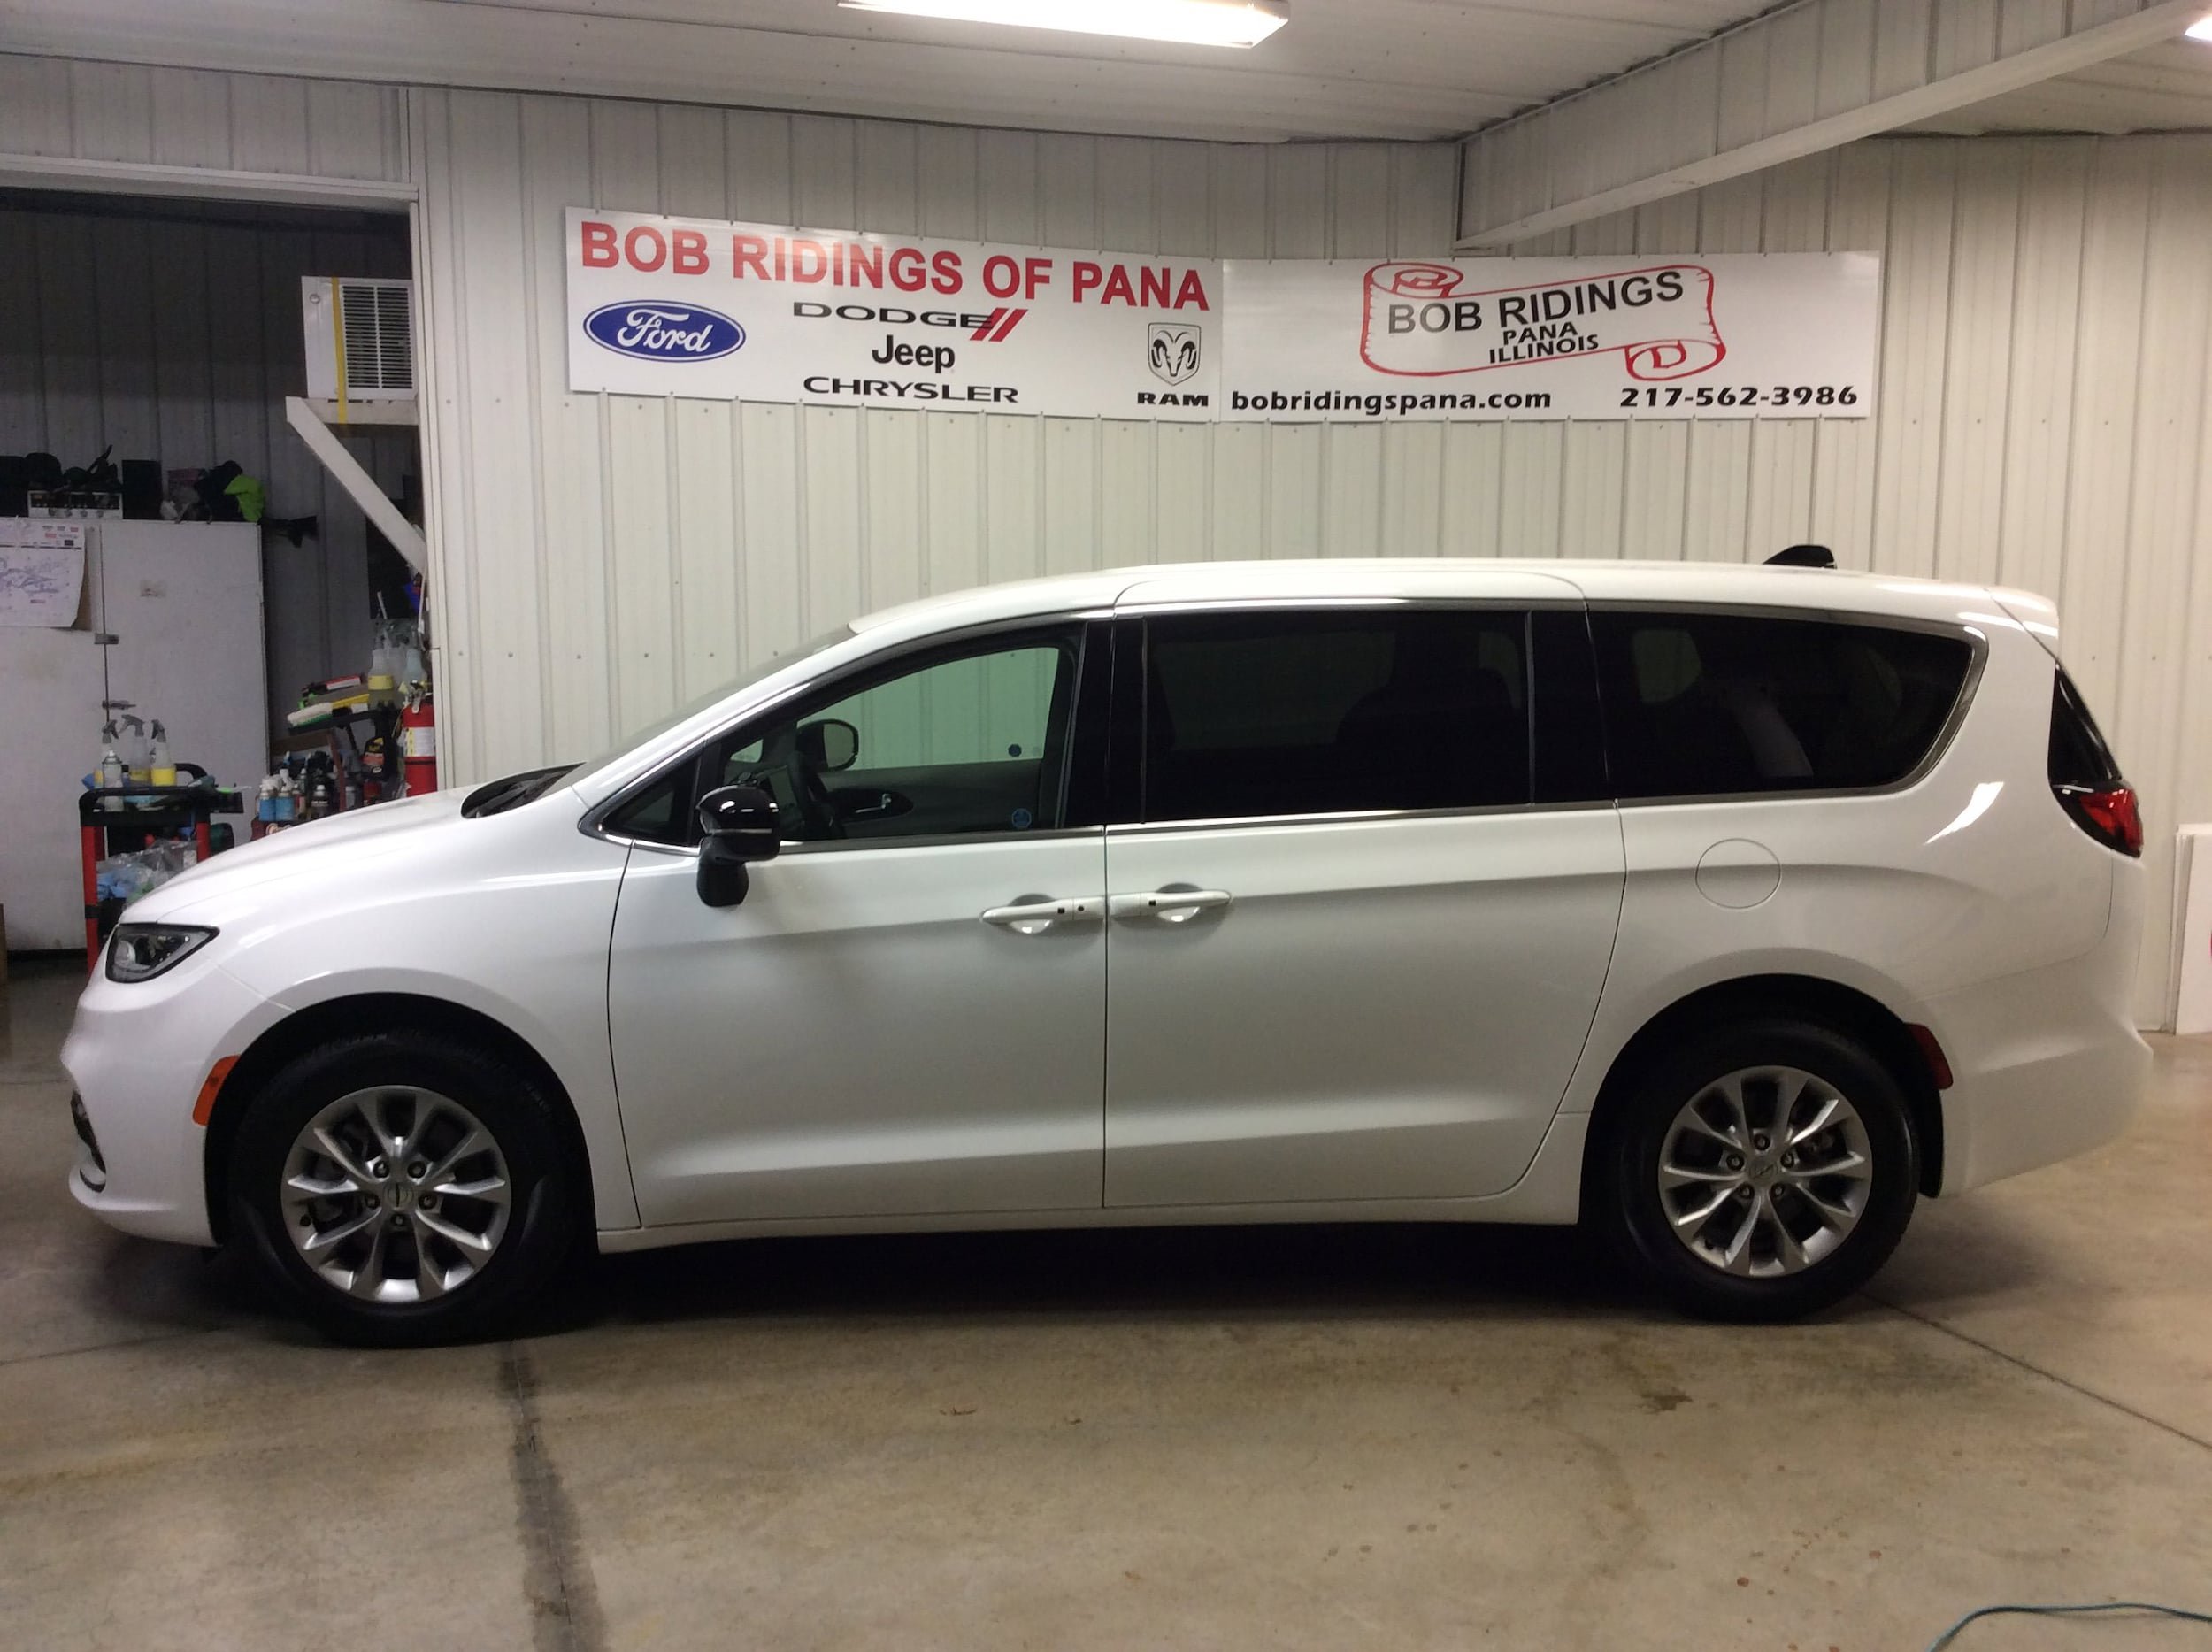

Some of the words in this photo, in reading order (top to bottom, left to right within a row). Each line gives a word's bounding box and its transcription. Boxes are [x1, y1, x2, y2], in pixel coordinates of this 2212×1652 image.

[581, 221, 709, 275] BOB
[733, 234, 964, 295] RIDINGS
[983, 255, 1053, 299] OF
[1073, 260, 1210, 311] PANA
[793, 302, 995, 329] DODGE
[1388, 302, 1482, 334] BOB
[1498, 271, 1684, 327] RIDINGS
[617, 309, 714, 352] Ford
[1503, 321, 1578, 345] PANA
[872, 334, 956, 373] Jeep
[1489, 334, 1599, 364] ILLINOIS
[803, 376, 1018, 403] CHRYSLER
[1137, 392, 1209, 407] RAM
[1231, 390, 1551, 416] bobridingspana.com
[1620, 386, 1857, 408] 217-562-3986
